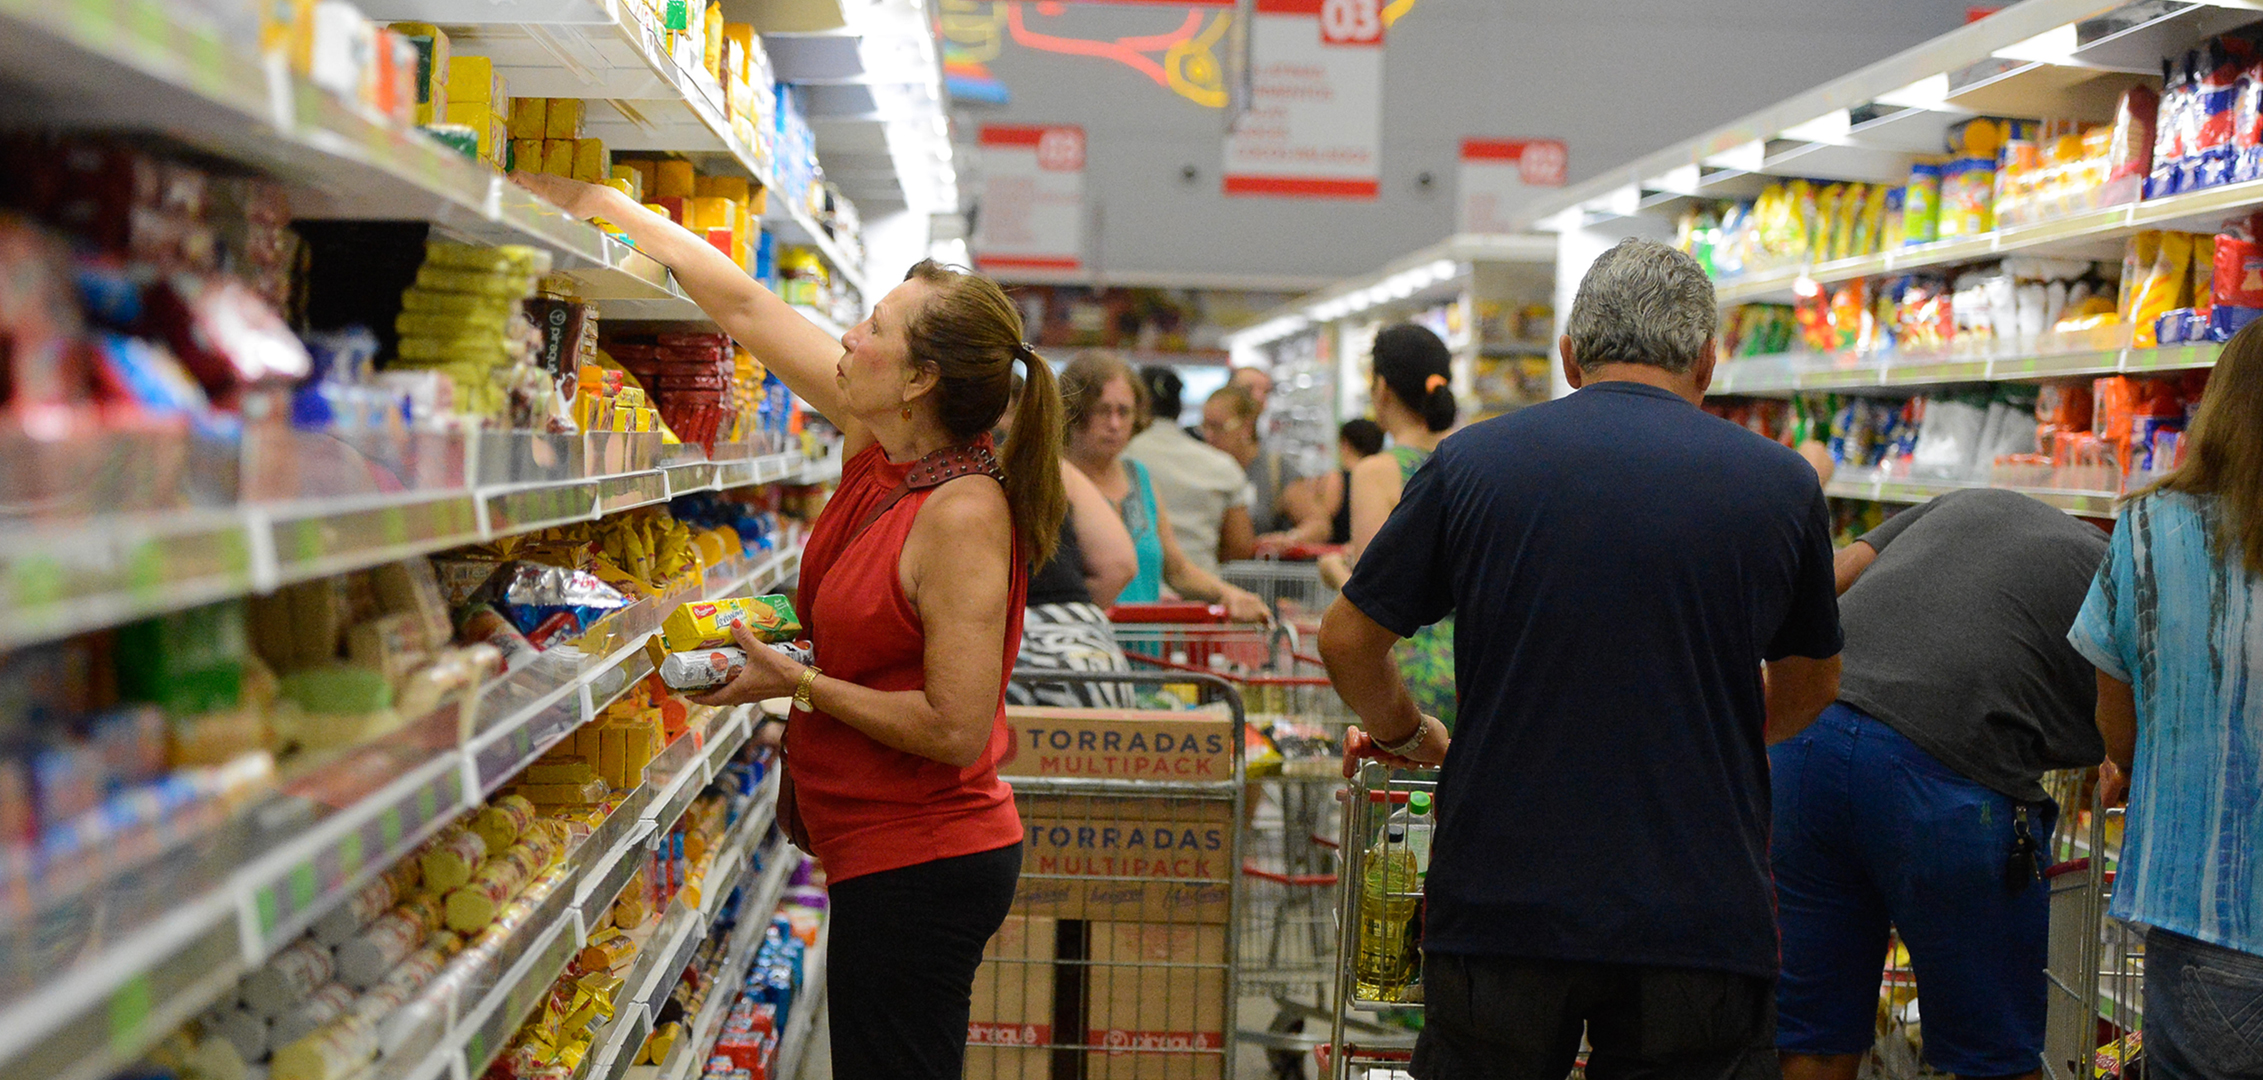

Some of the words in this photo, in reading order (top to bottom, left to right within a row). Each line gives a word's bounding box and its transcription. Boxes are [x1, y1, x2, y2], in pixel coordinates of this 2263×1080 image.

[1323, 0, 1379, 39] 03
[1027, 729, 1223, 754] TORRADAS
[1040, 756, 1212, 776] MULTIPACK
[1029, 826, 1221, 850] TORRADAS
[1039, 856, 1211, 878] MULTIPACK
